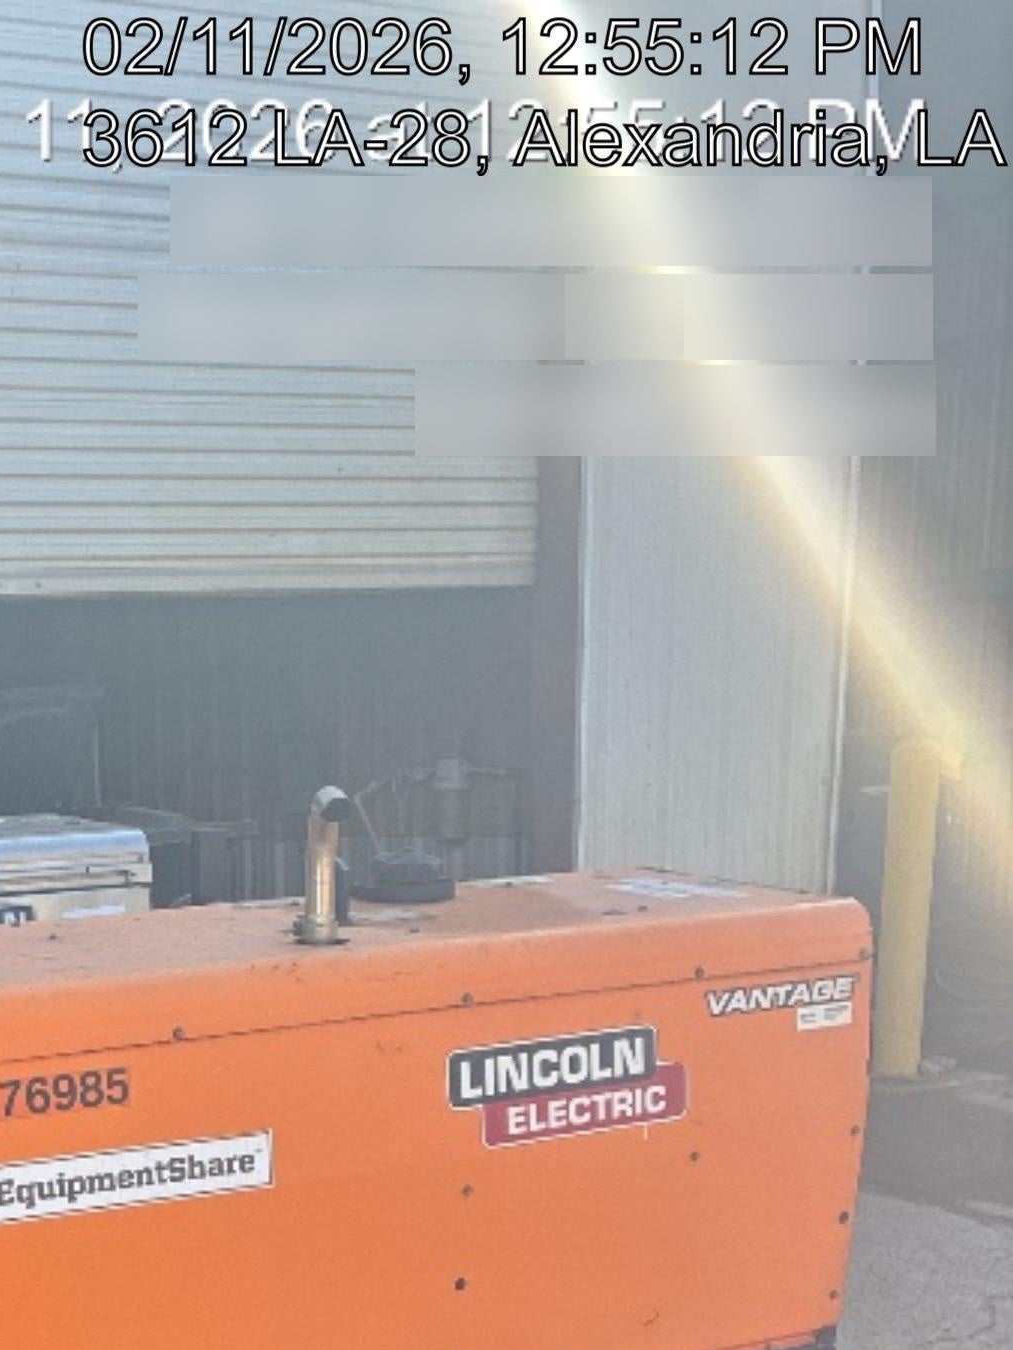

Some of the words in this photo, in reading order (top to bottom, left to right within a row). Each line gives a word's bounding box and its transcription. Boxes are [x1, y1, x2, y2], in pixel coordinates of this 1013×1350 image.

[706, 976, 856, 1016] VANTAGE
[459, 1037, 646, 1099] LINCOLN
[507, 1085, 667, 1136] ELECTRIC
